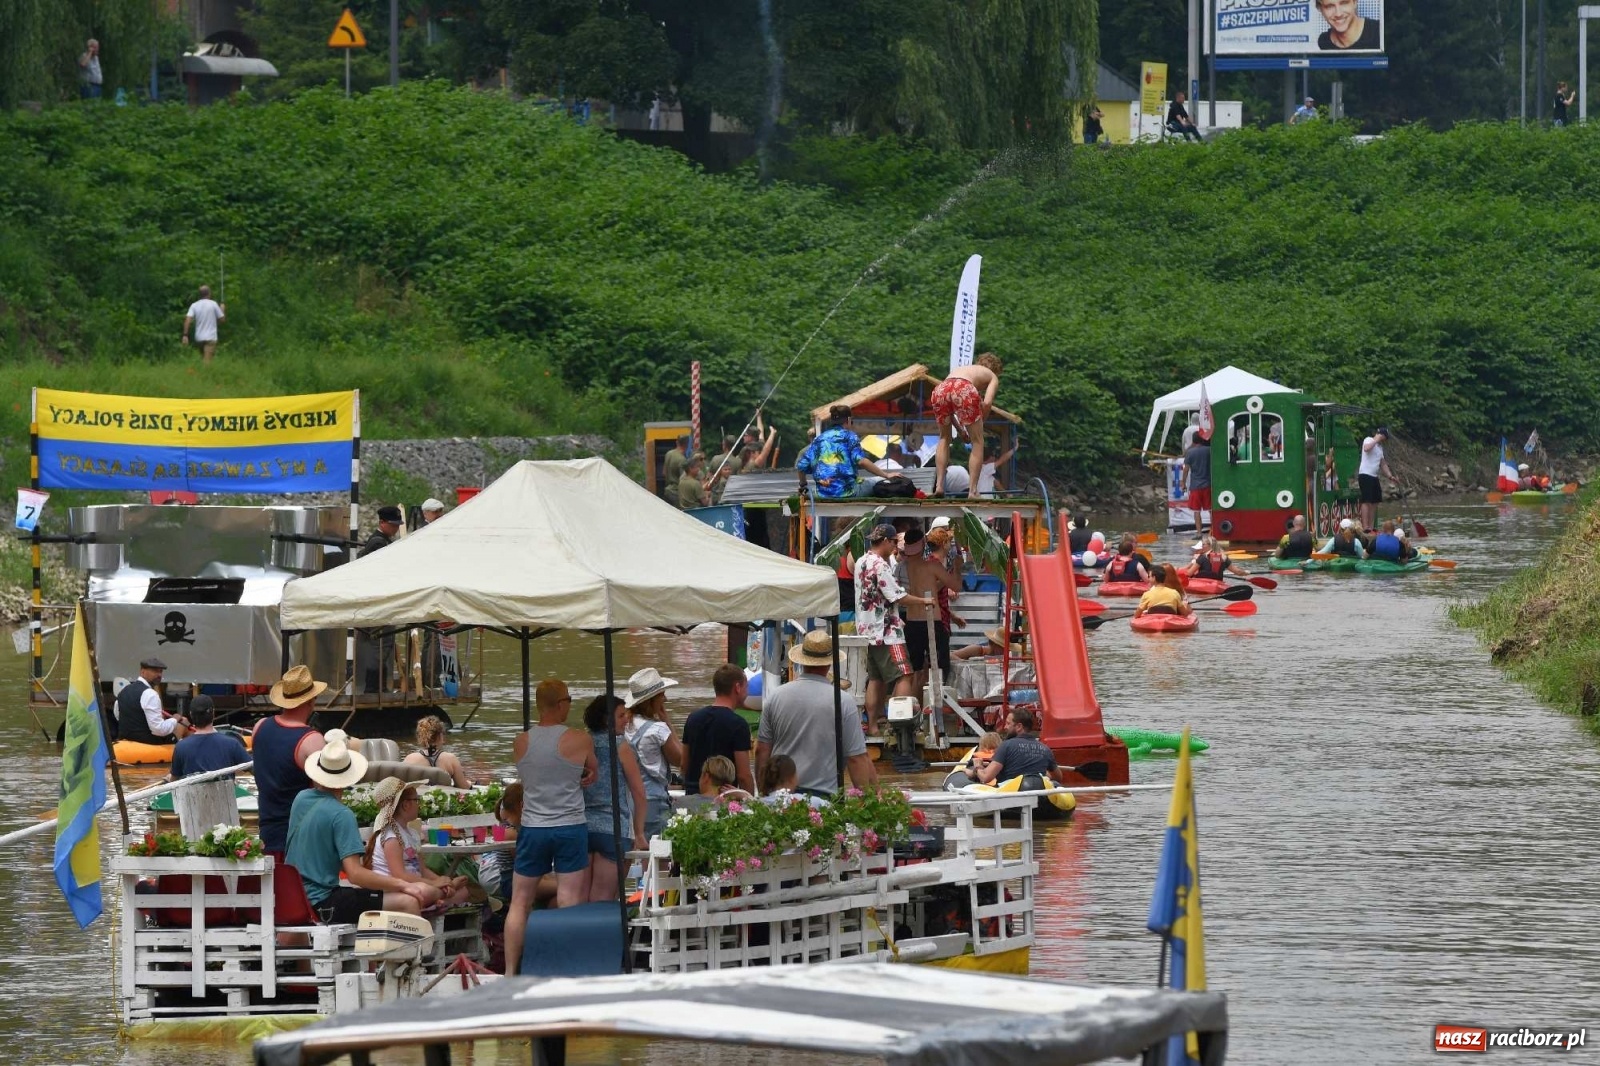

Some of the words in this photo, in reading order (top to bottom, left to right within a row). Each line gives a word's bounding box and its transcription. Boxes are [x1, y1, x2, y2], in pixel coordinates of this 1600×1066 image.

[1220, 6, 1307, 28] #SZCZEPIMYSIĘ
[958, 291, 968, 366] odociągi
[964, 294, 974, 366] ciborskie
[393, 923, 419, 932] Johnson
